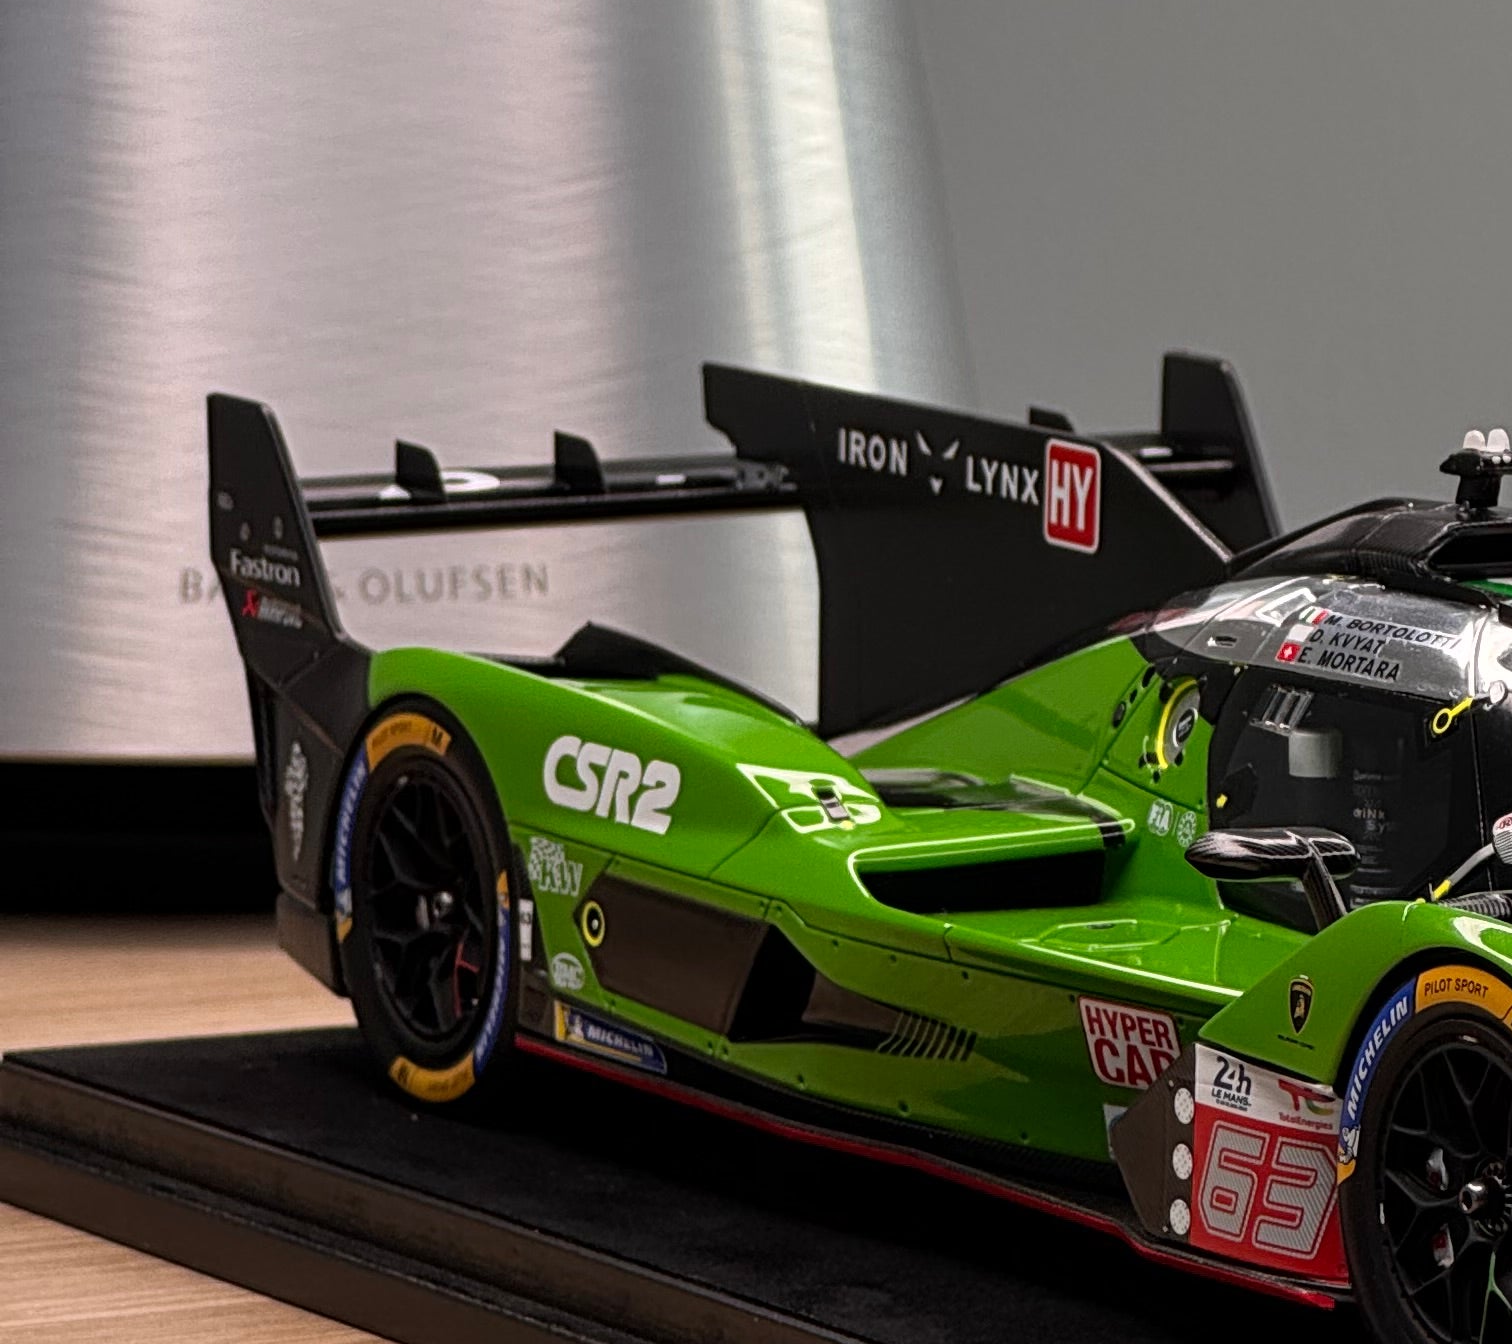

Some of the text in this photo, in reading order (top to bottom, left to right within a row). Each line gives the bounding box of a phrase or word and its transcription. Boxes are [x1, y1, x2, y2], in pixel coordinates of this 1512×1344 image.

[838, 427, 1039, 506] IRON LYNX
[1049, 459, 1094, 532] HY
[230, 547, 301, 588] Fastron
[358, 562, 549, 603] OLUFSEN
[1309, 629, 1386, 656] D. KVYAT
[1323, 615, 1463, 650] M. BORTOLOTTI
[1297, 646, 1401, 682] E. MORTARA
[543, 735, 681, 835] CSR2
[1424, 978, 1489, 999] PILOT SPORT
[587, 1020, 656, 1058] MICHELIN
[1085, 1004, 1173, 1051] HYPER
[1213, 1056, 1252, 1096] 24h
[1347, 996, 1409, 1121] MICHELIN
[1211, 1087, 1223, 1100] LE
[1278, 1112, 1334, 1131] TotalEnergies
[1198, 1119, 1338, 1261] 63
